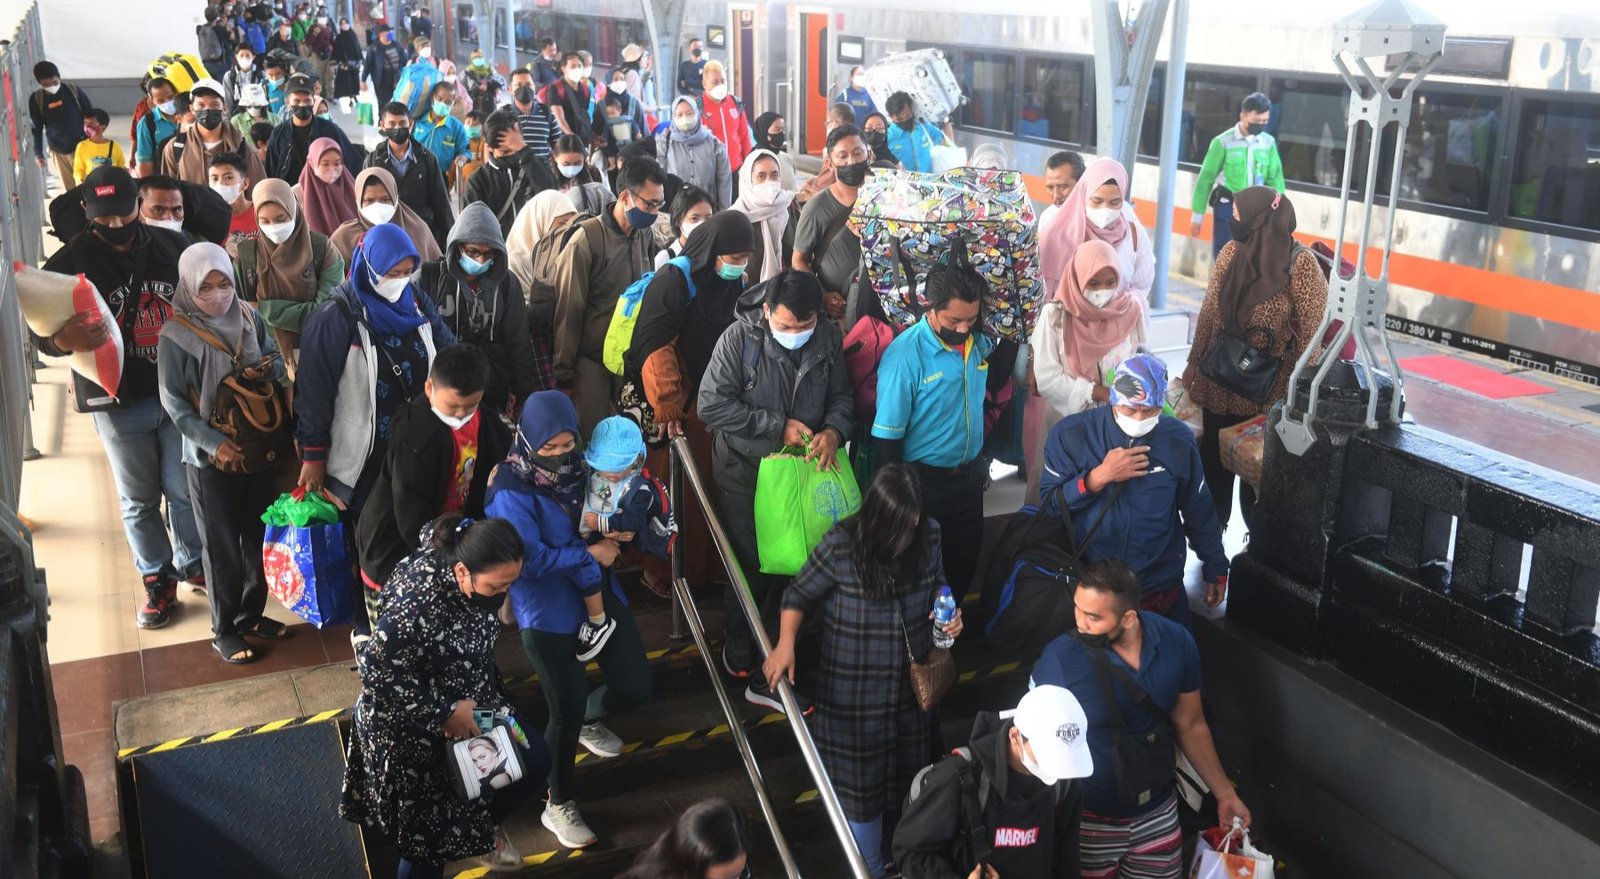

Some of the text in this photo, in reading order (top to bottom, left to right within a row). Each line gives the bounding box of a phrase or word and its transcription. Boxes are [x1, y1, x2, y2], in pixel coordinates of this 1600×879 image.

[1385, 318, 1401, 331] 220
[1408, 324, 1426, 337] 380
[1427, 329, 1436, 339] V
[994, 828, 1037, 847] MARVEL
